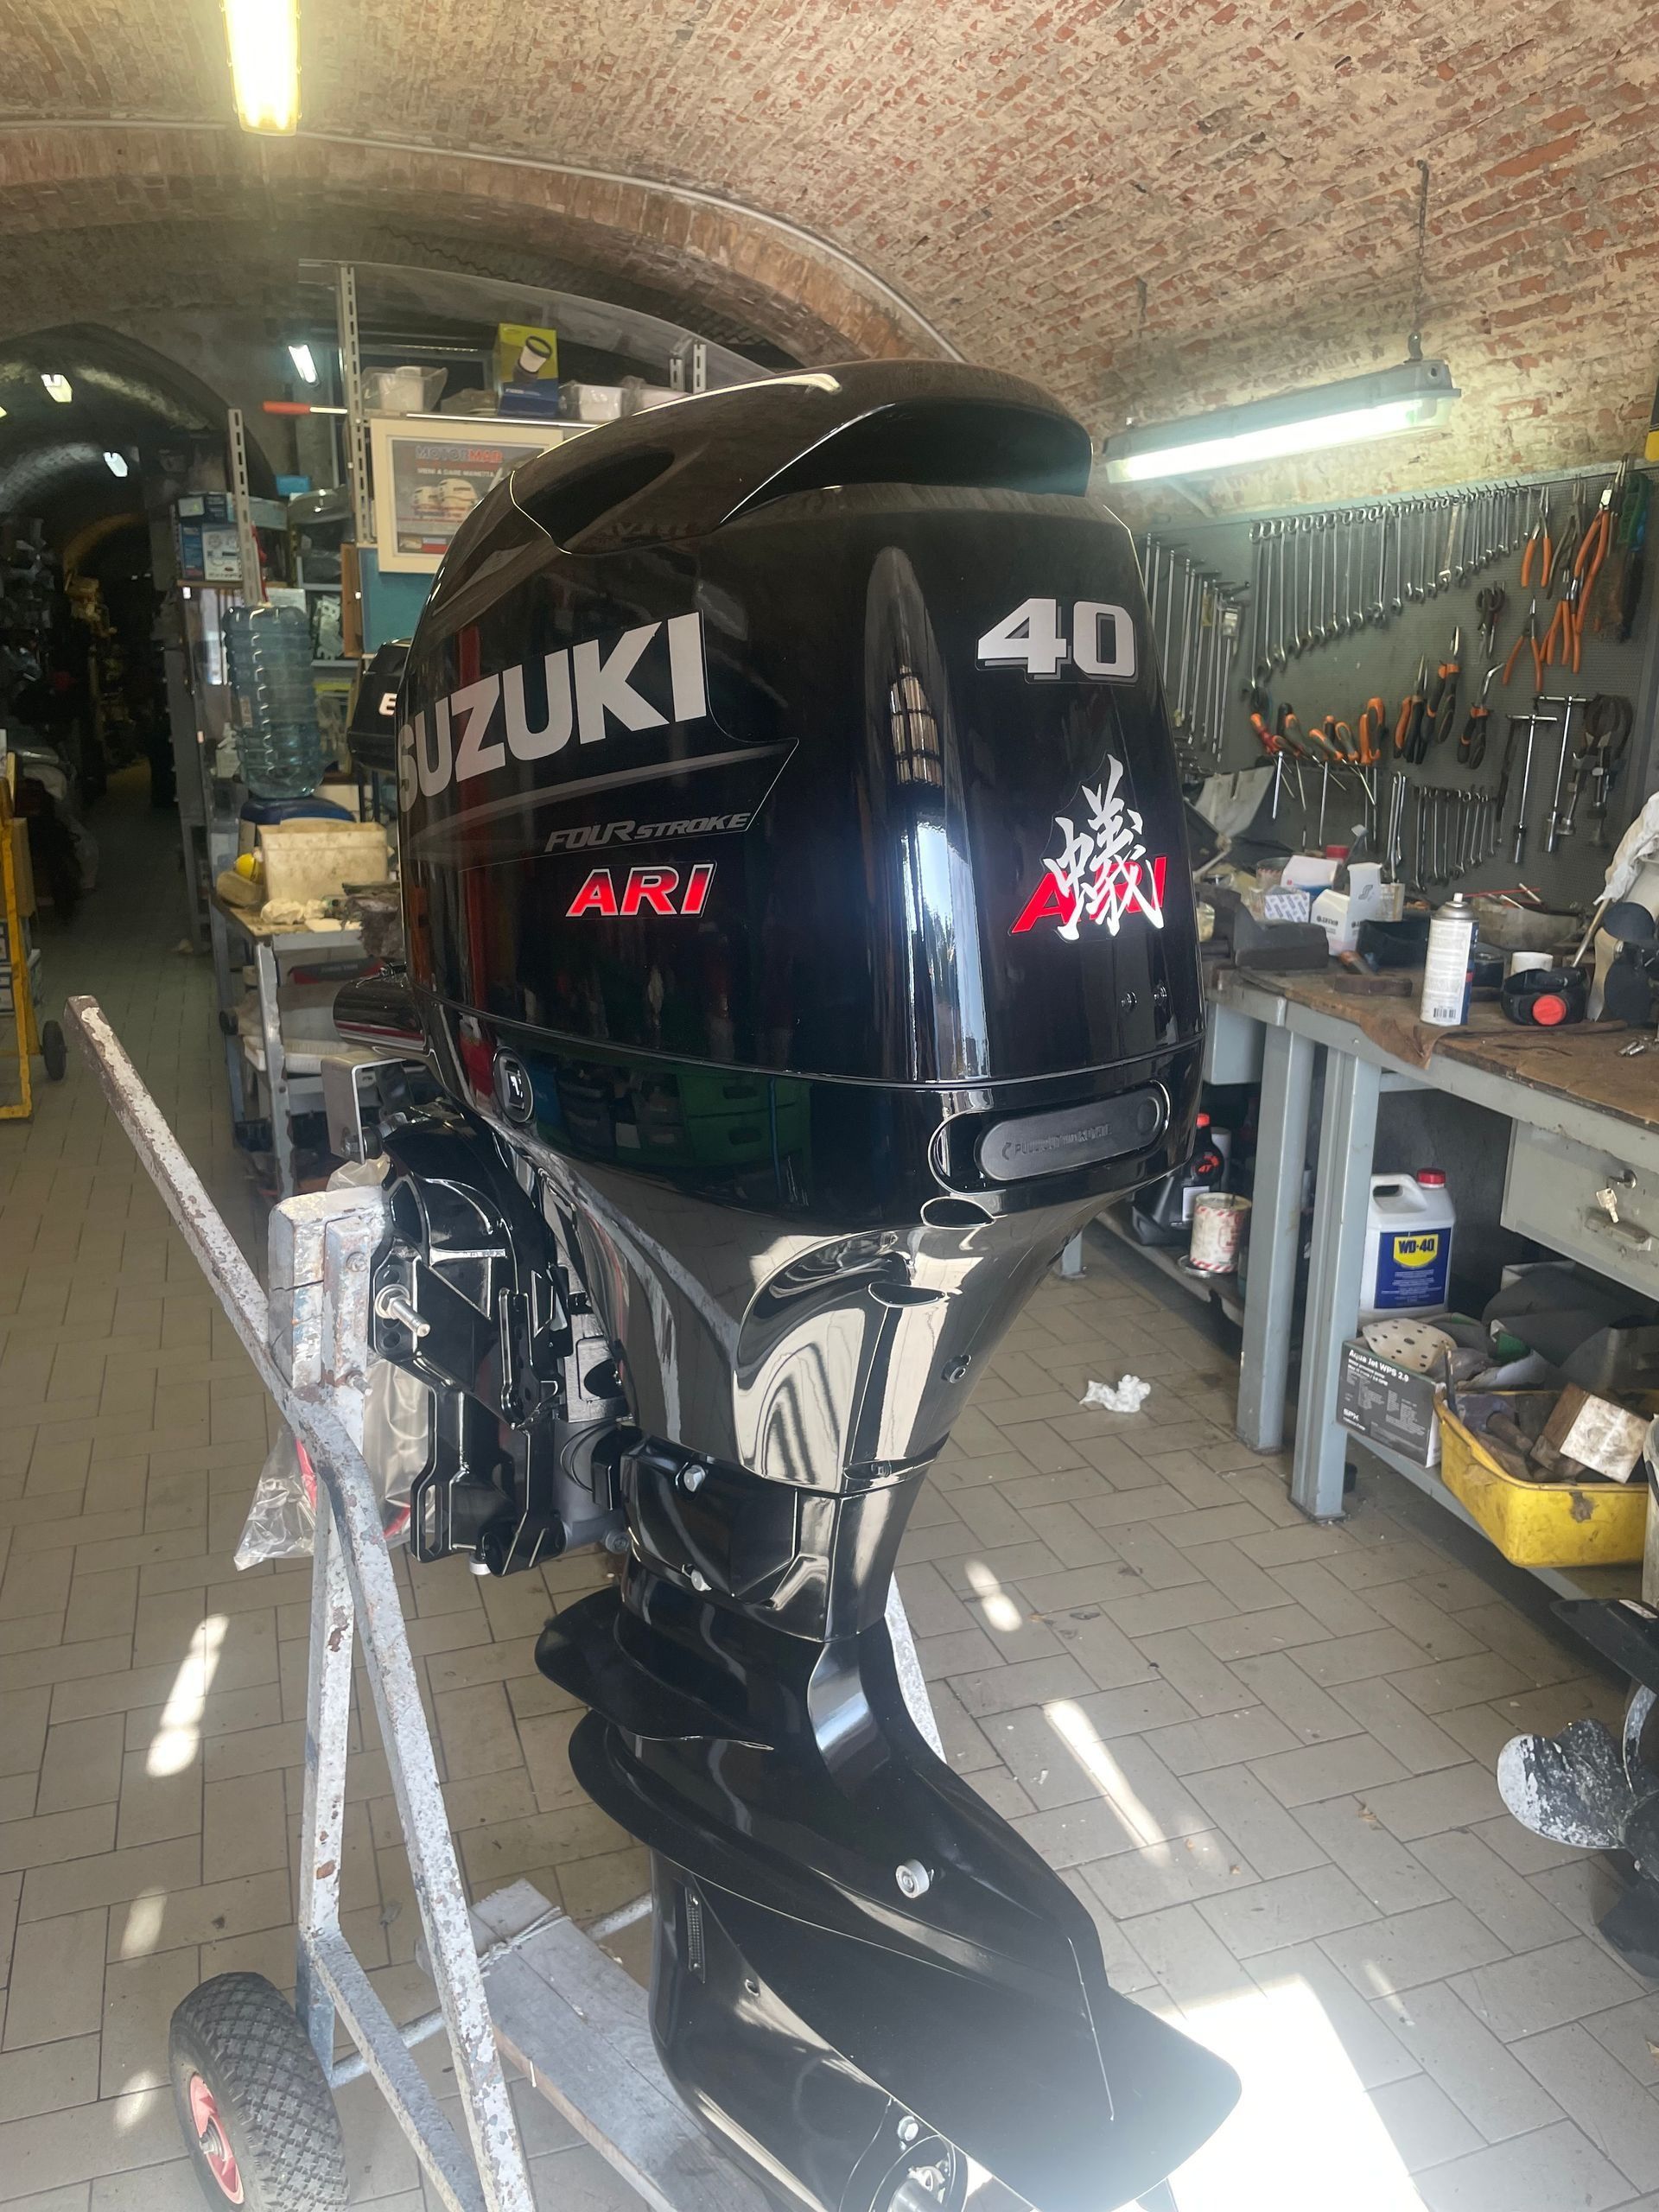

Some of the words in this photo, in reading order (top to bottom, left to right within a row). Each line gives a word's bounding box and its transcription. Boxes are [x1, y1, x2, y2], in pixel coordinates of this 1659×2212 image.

[977, 598, 1136, 678] 40
[398, 612, 707, 812] SUZUKI
[565, 864, 714, 917] ARI
[1398, 1238, 1435, 1254] WD-40
[1349, 1350, 1367, 1363] Aqua
[1368, 1358, 1378, 1369] Jet
[1380, 1363, 1396, 1377] WPS
